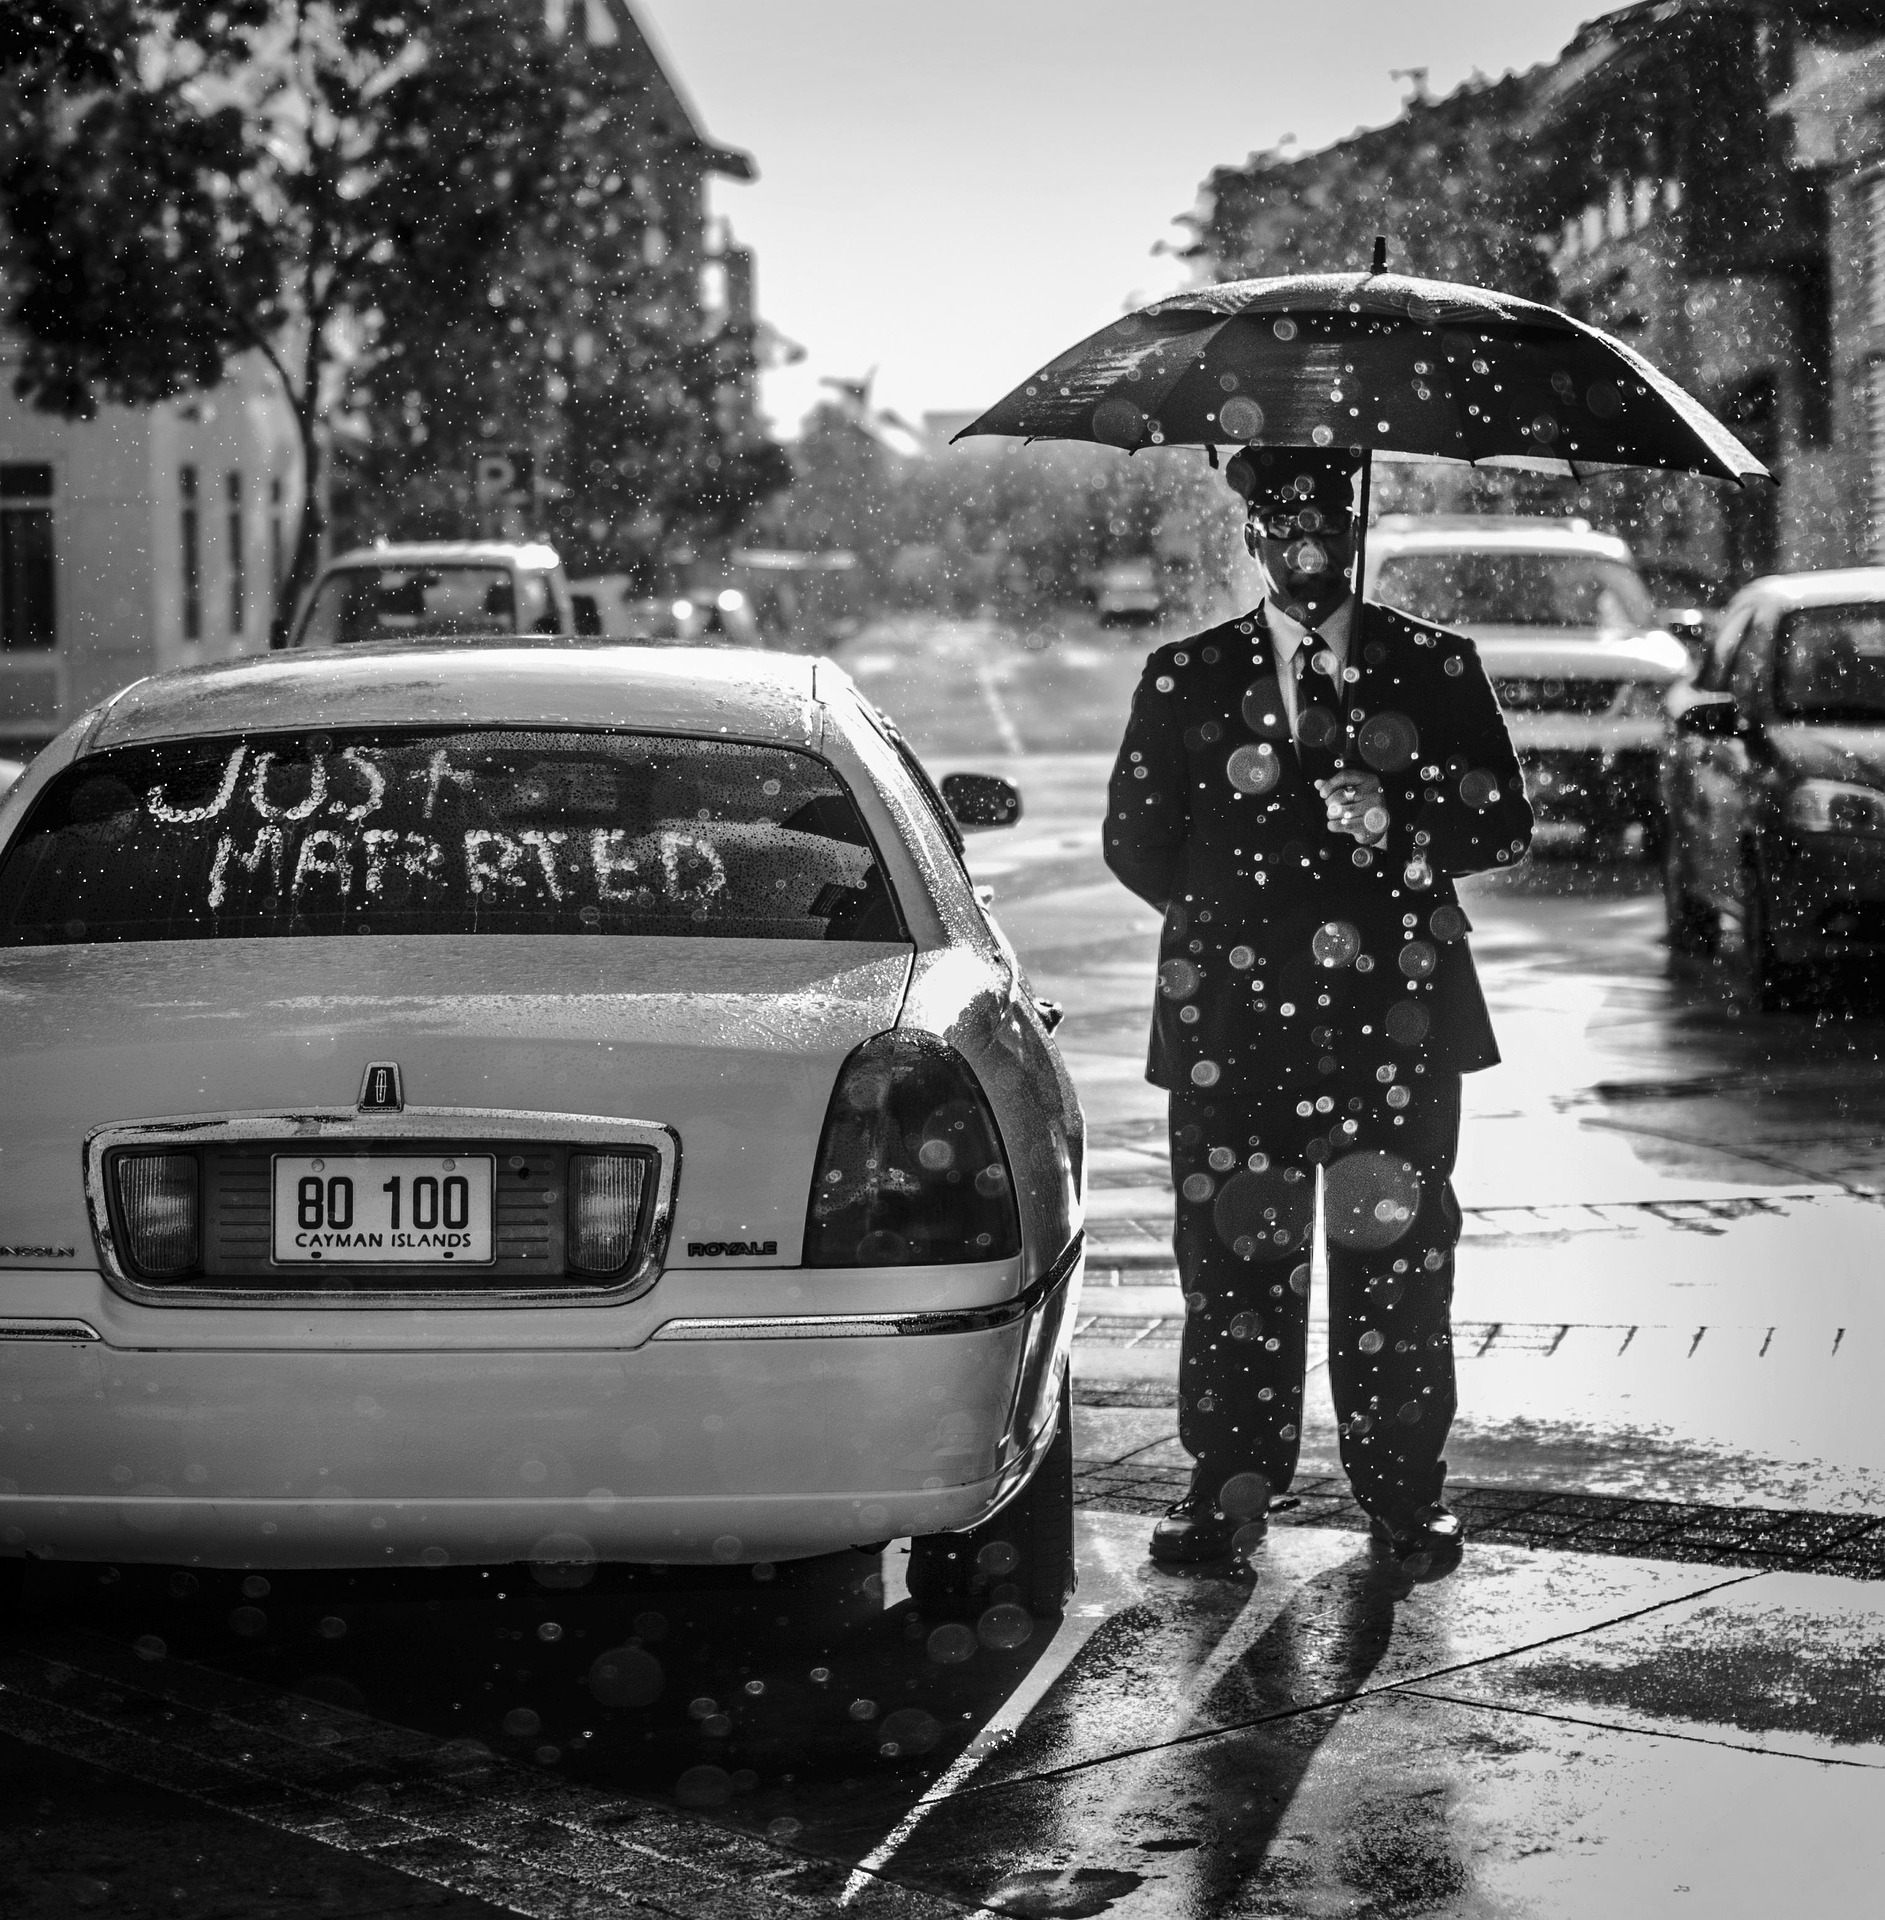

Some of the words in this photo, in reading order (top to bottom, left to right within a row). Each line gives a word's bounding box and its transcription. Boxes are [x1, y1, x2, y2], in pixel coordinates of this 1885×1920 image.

[298, 1176, 353, 1230] 80
[383, 1176, 469, 1230] 100
[295, 1233, 383, 1248] CAYMAN
[391, 1233, 471, 1248] ISLANDS
[0, 1246, 75, 1257] INCOLN
[687, 1241, 777, 1257] ROYALE
